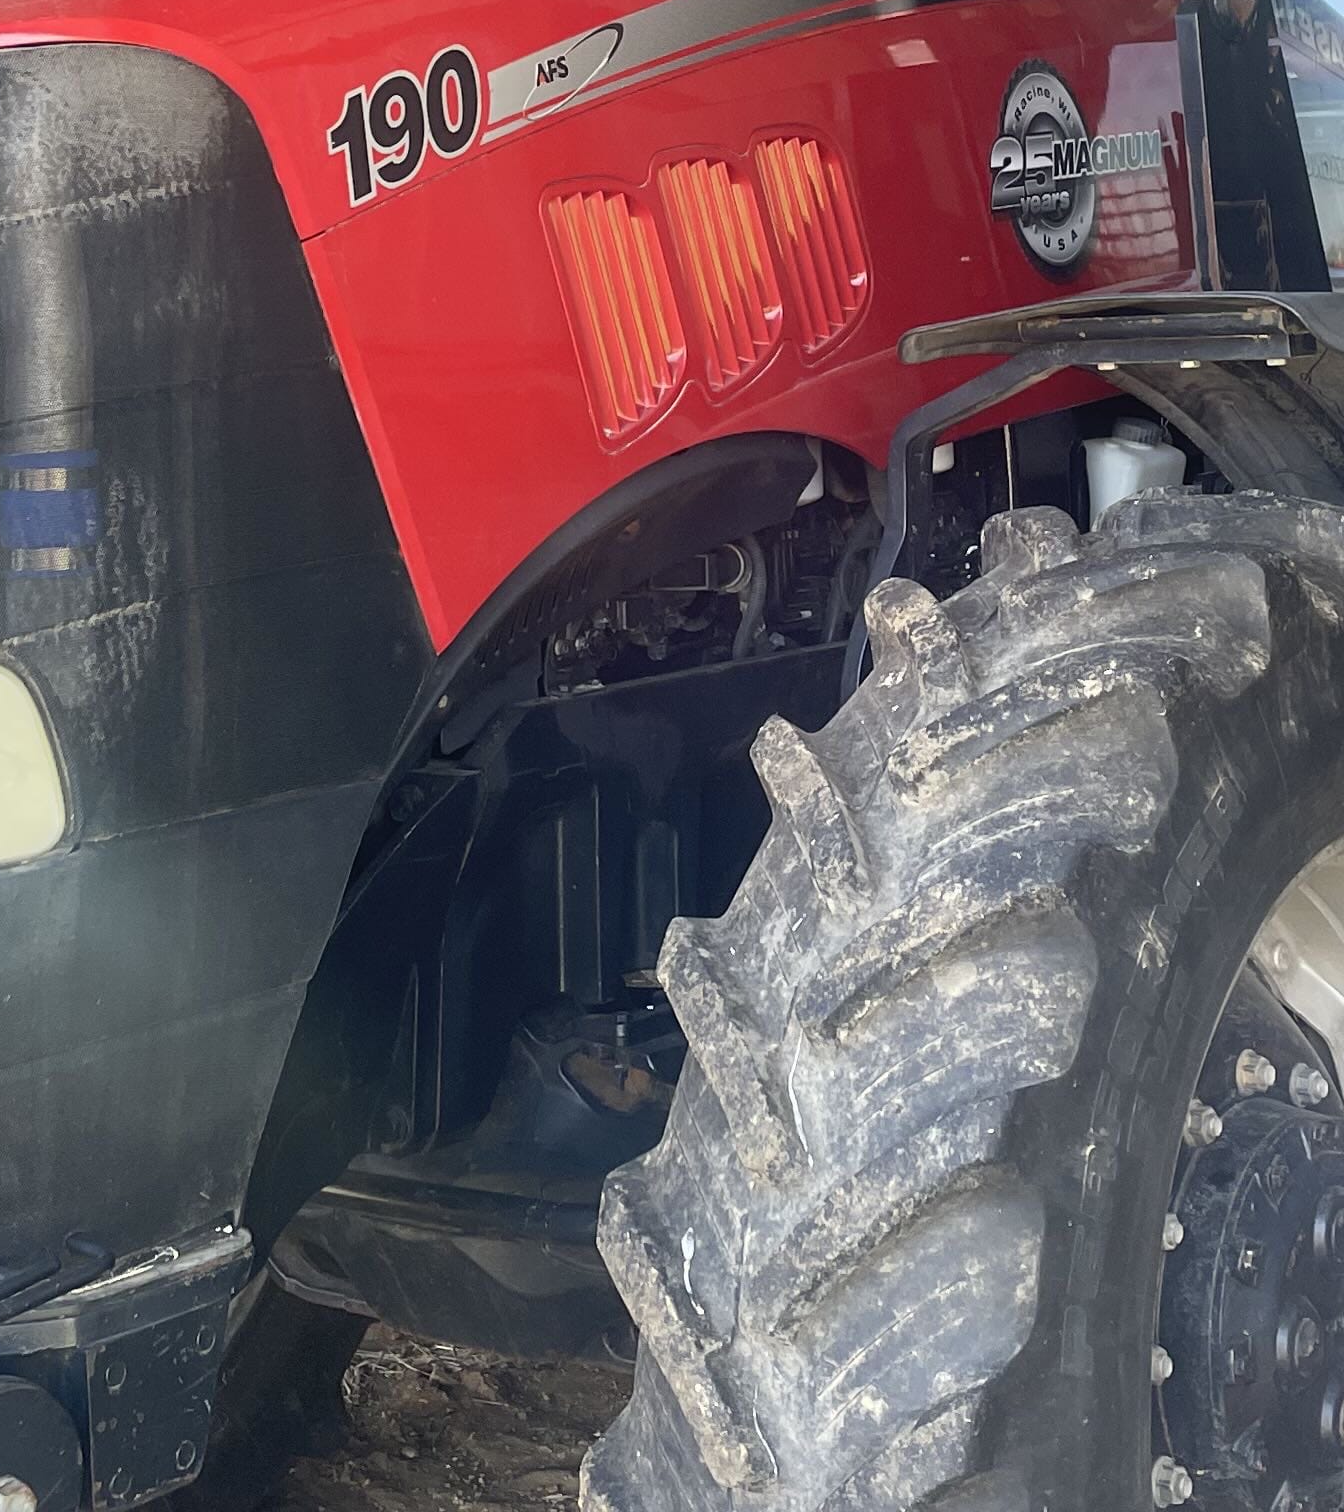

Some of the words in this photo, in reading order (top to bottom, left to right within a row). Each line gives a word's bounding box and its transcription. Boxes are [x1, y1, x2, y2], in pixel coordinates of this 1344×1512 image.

[536, 55, 569, 88] AFS
[328, 45, 481, 208] 190
[990, 130, 1054, 211] 25
[1052, 129, 1163, 180] MAGNUM
[1020, 190, 1070, 219] years
